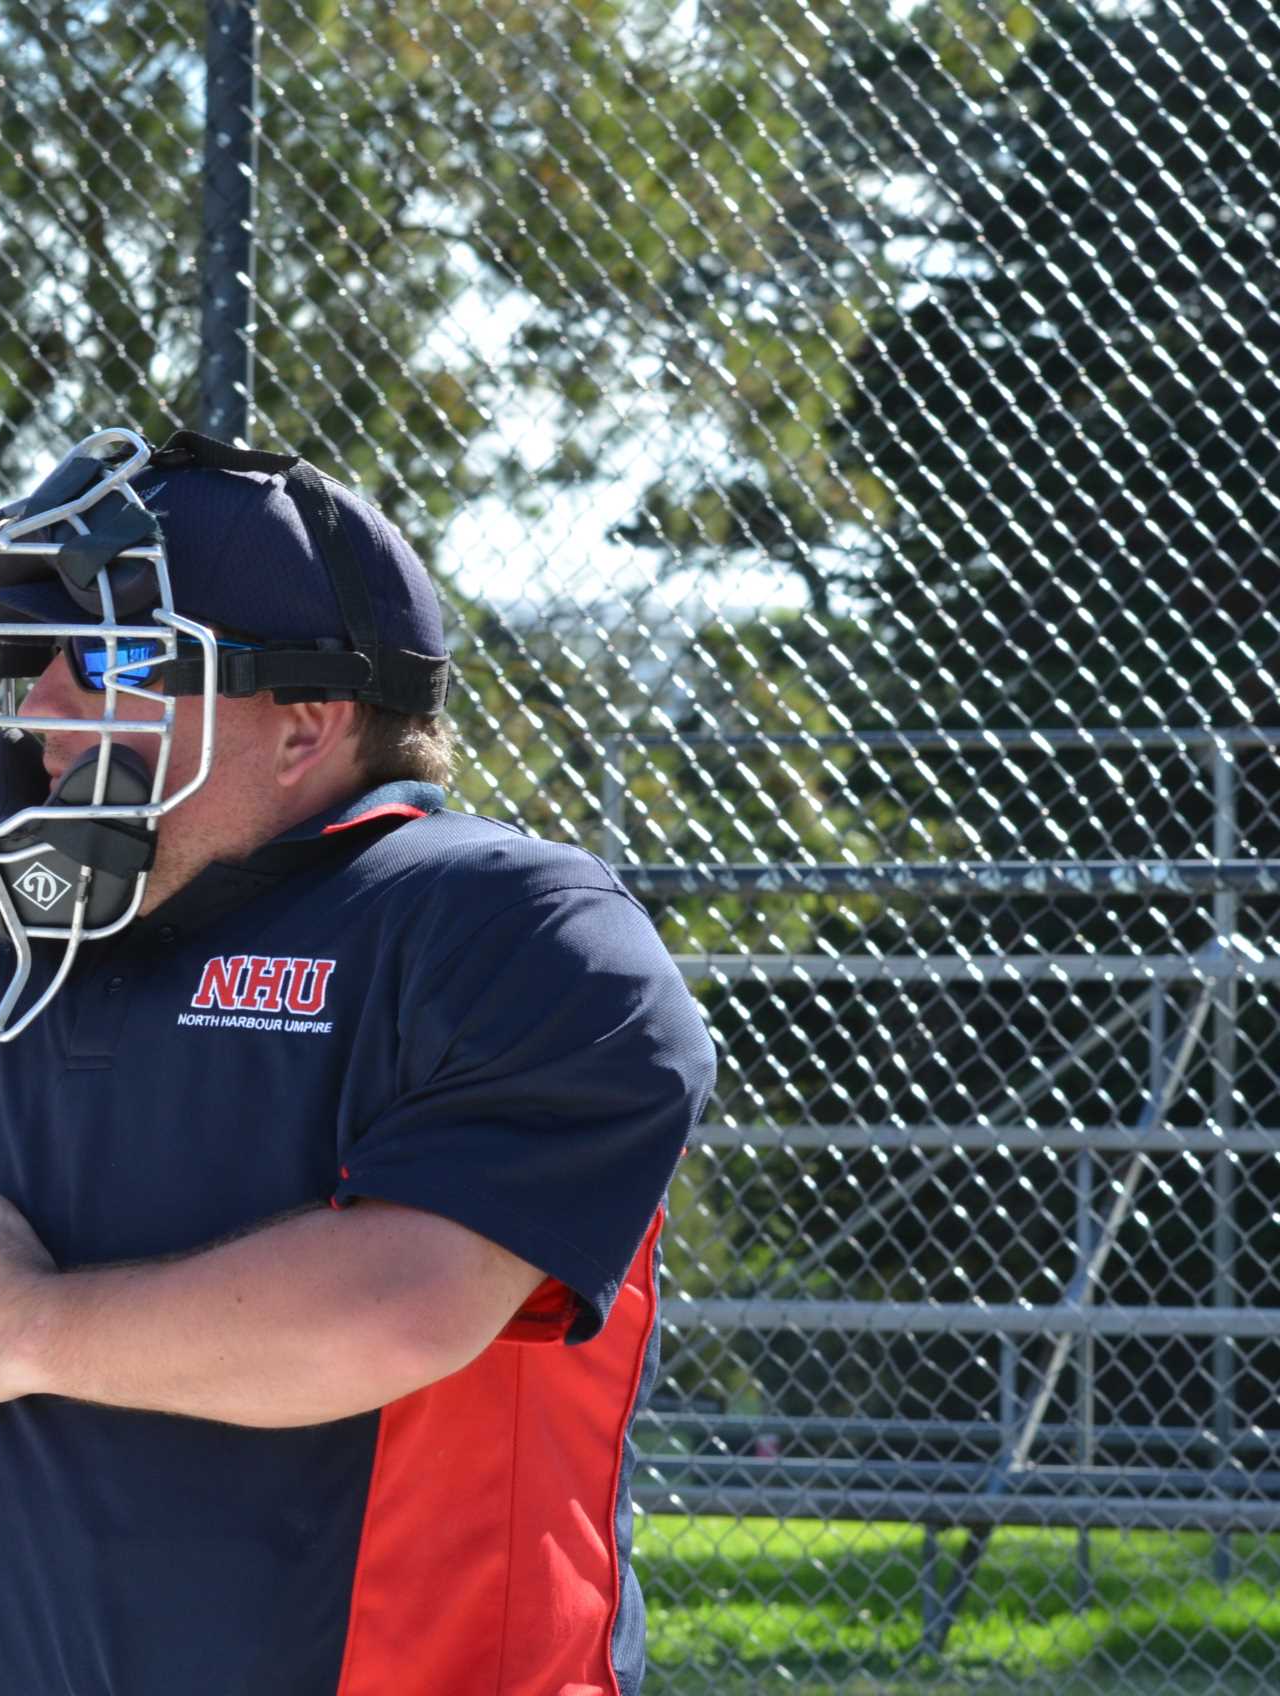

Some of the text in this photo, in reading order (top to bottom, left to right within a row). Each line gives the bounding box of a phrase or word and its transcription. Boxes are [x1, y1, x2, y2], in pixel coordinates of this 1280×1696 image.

[23, 871, 57, 902] D
[191, 955, 336, 1015] NHU
[177, 1013, 333, 1033] NORTH HARBOUR UMPIRE
